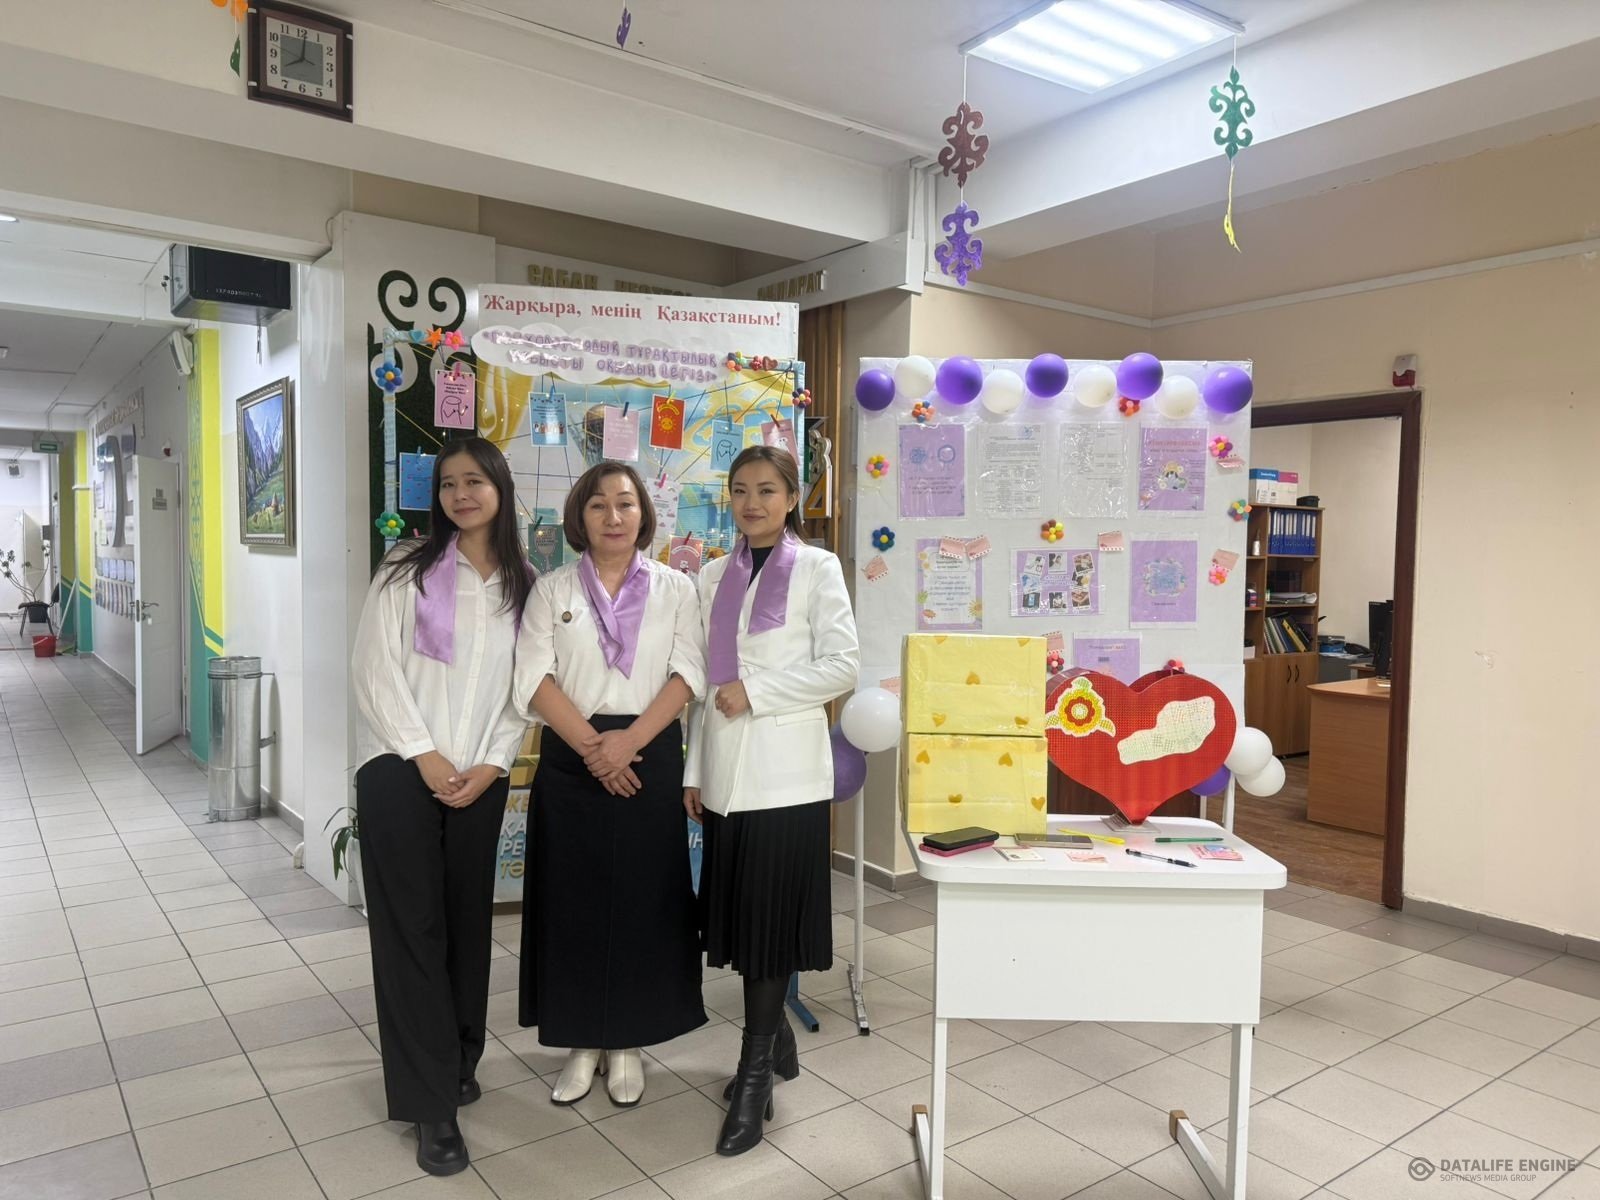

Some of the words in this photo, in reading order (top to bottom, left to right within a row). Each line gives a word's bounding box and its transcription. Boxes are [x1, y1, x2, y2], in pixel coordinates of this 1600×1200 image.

[280, 23, 290, 35] 11
[296, 28, 308, 39] 12
[269, 31, 279, 42] 10
[270, 48, 278, 59] 9
[326, 46, 334, 57] 2
[270, 64, 278, 75] 8
[326, 62, 334, 73] 3
[281, 79, 289, 89] 7
[298, 83, 306, 93] 6
[326, 79, 333, 89] 4
[315, 88, 323, 97] 5
[484, 294, 582, 318] Жарқыра,
[591, 303, 642, 320] менің
[657, 304, 781, 326] Қазақстаным!
